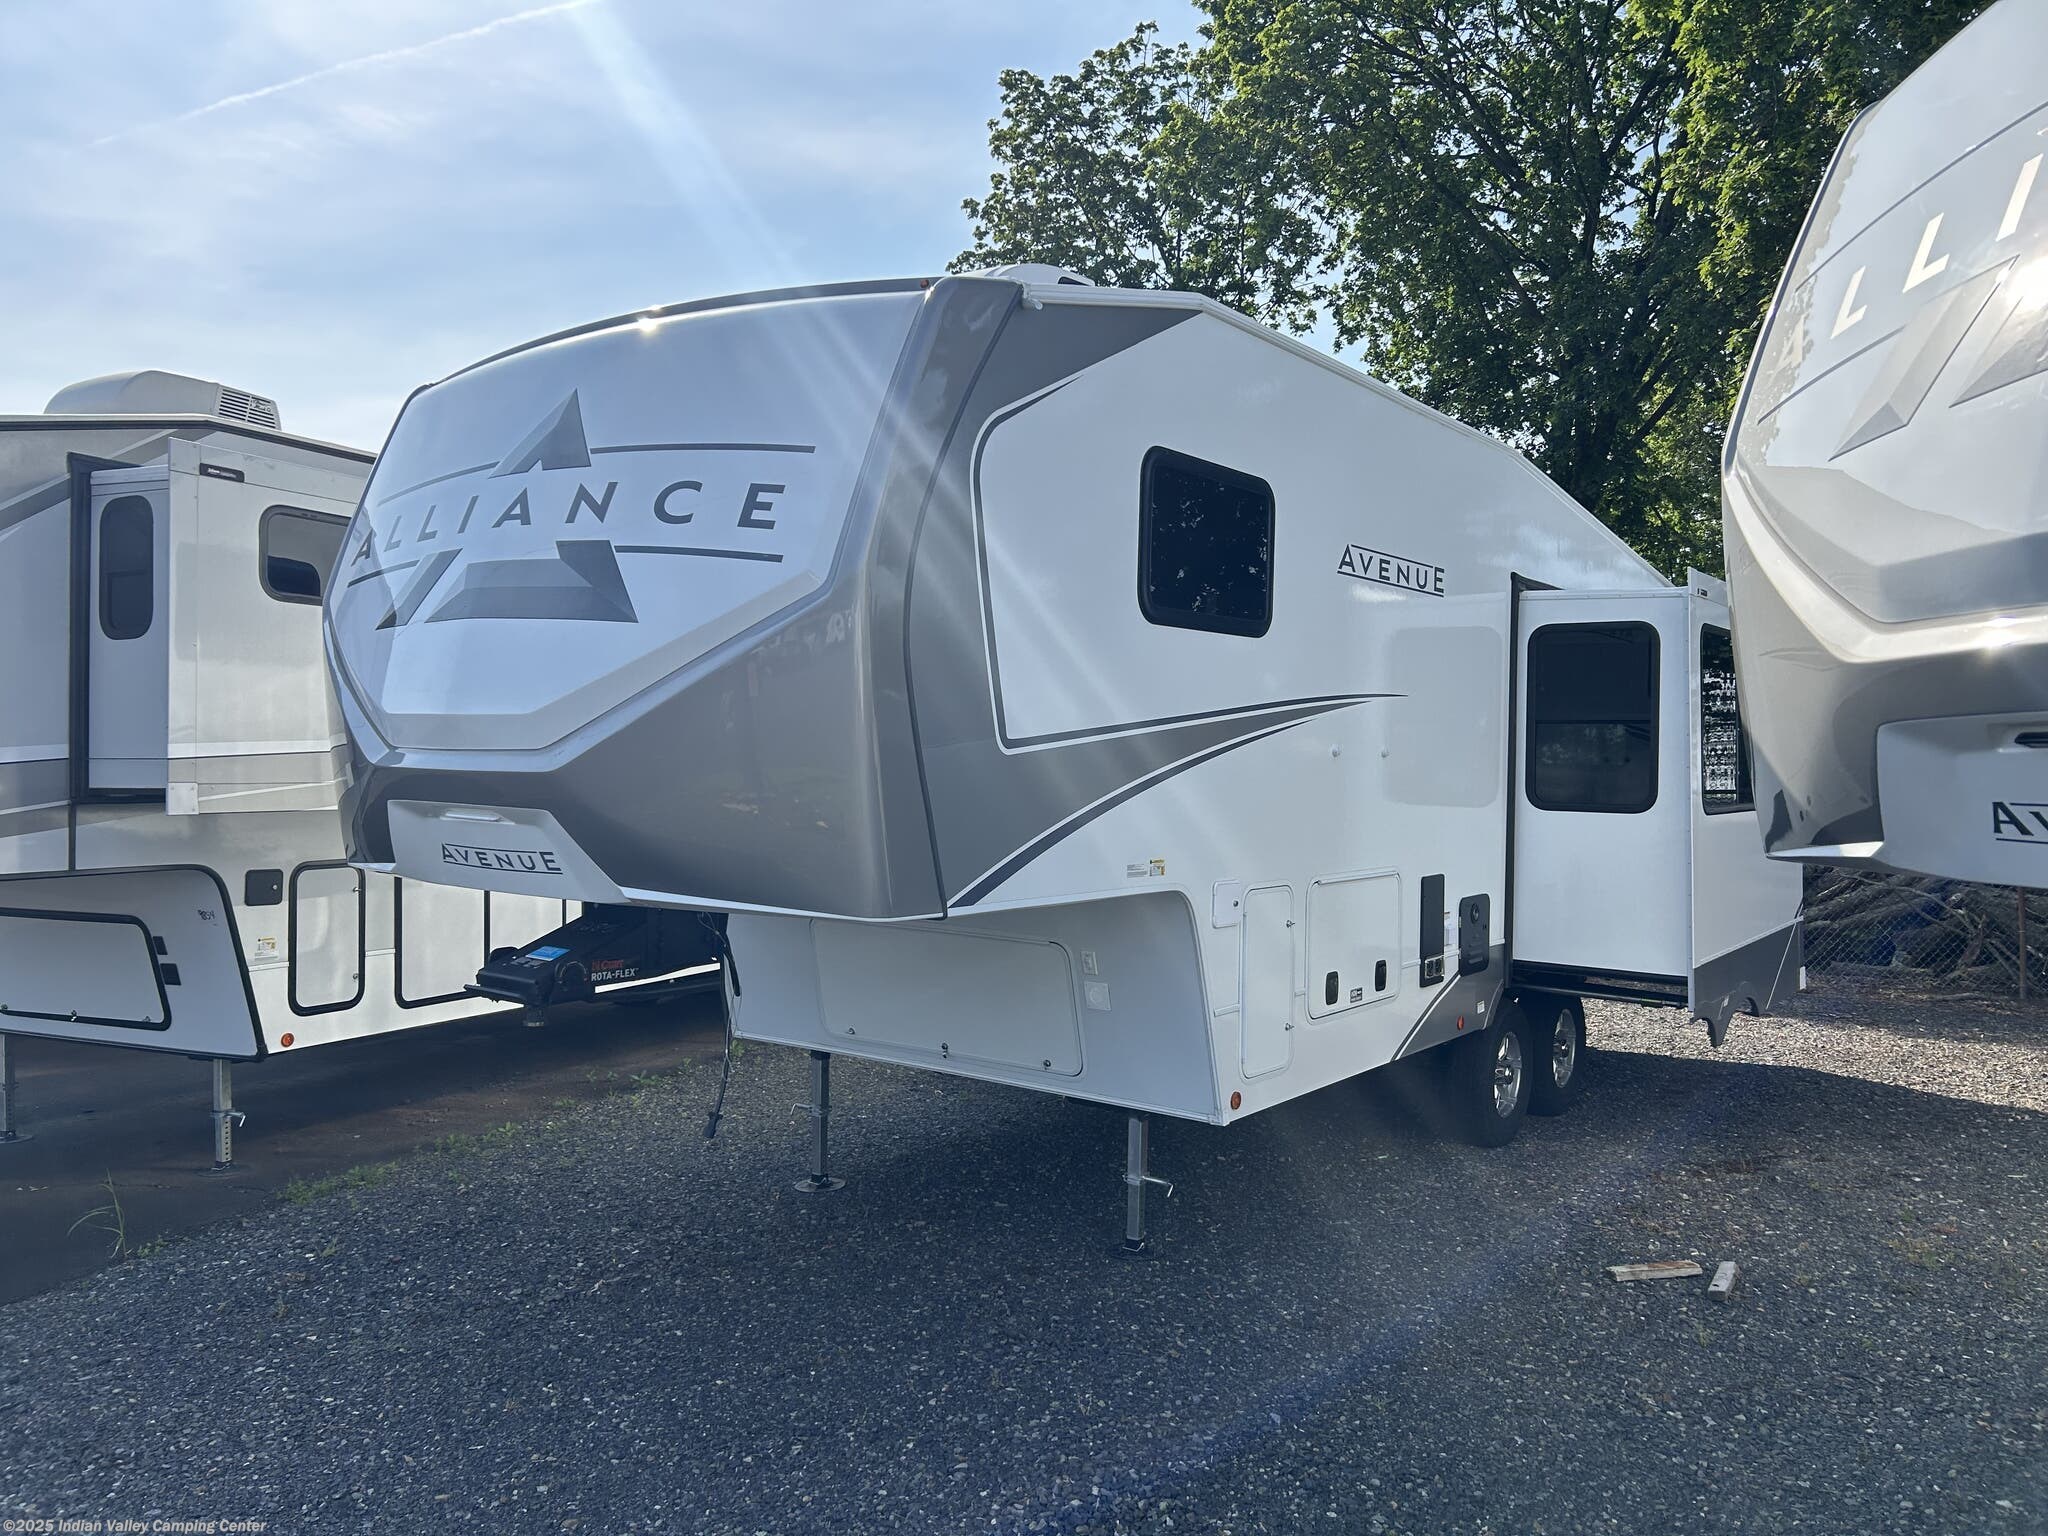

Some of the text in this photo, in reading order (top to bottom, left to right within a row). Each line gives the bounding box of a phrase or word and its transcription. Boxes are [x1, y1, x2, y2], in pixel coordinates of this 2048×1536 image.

[351, 480, 786, 567] ALLIANCE
[1338, 544, 1445, 593] AVENUE
[441, 843, 562, 871] AVENUE
